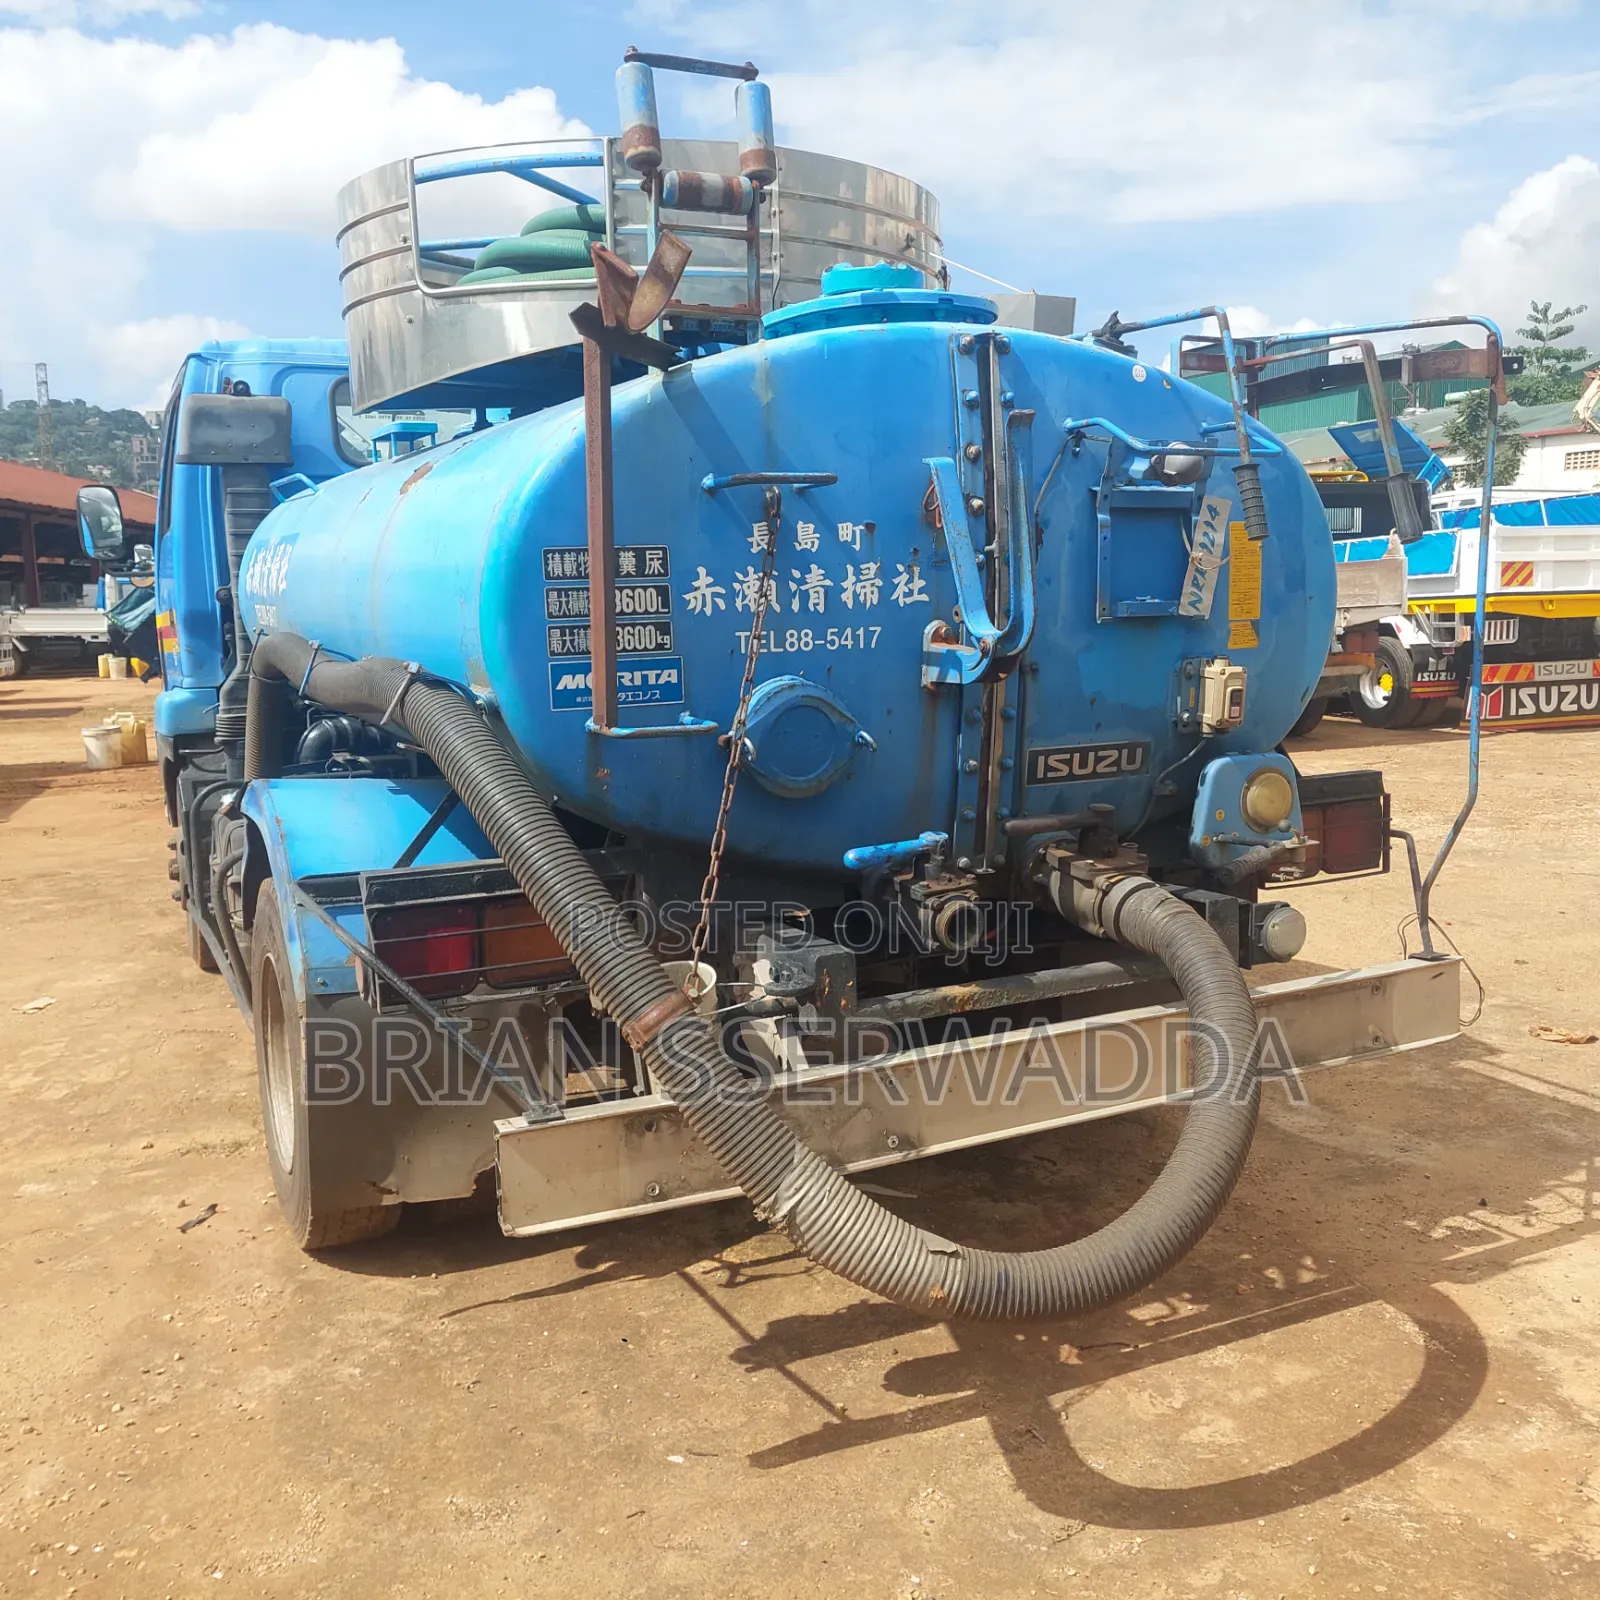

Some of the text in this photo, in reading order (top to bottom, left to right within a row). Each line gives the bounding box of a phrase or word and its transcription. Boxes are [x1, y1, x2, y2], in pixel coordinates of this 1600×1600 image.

[747, 520, 865, 553] 長島町
[547, 590, 591, 616] 最大積載
[681, 563, 930, 617] 赤瀬清掃社
[735, 626, 882, 654] TEL88-5417
[1417, 672, 1456, 682] ISUZU
[1537, 662, 1588, 677] ISUZU
[1509, 683, 1600, 716] ISUZU
[1036, 747, 1143, 779] ISUZU
